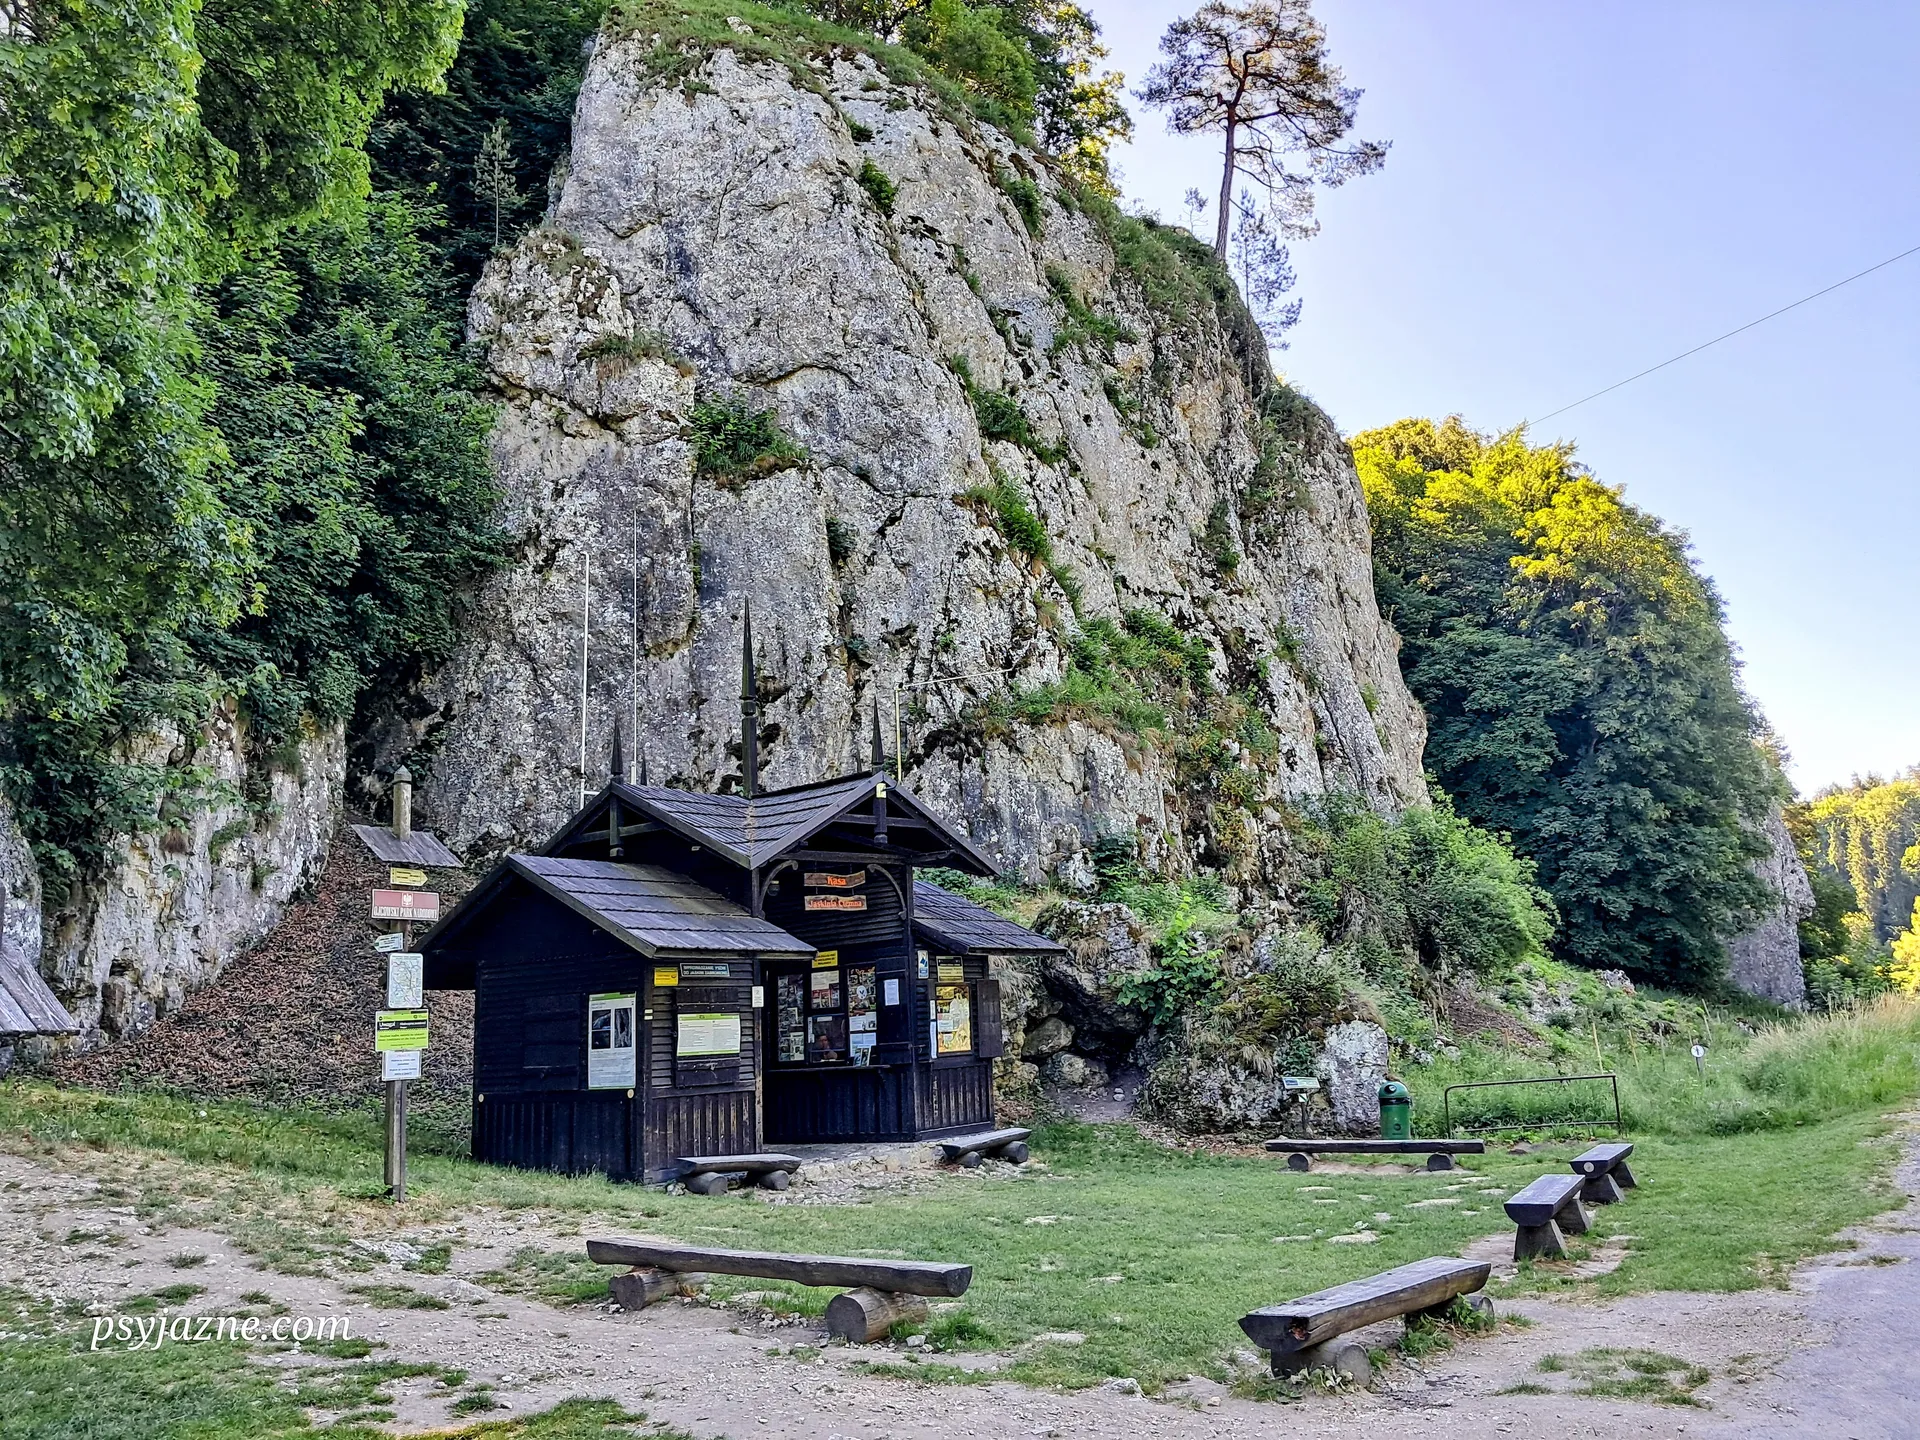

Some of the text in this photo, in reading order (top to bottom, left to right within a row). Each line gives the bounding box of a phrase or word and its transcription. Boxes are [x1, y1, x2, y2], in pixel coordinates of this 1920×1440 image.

[827, 876, 846, 886] Kasa
[808, 899, 862, 908] Jaskinia Ciemna
[400, 907, 413, 918] PARK
